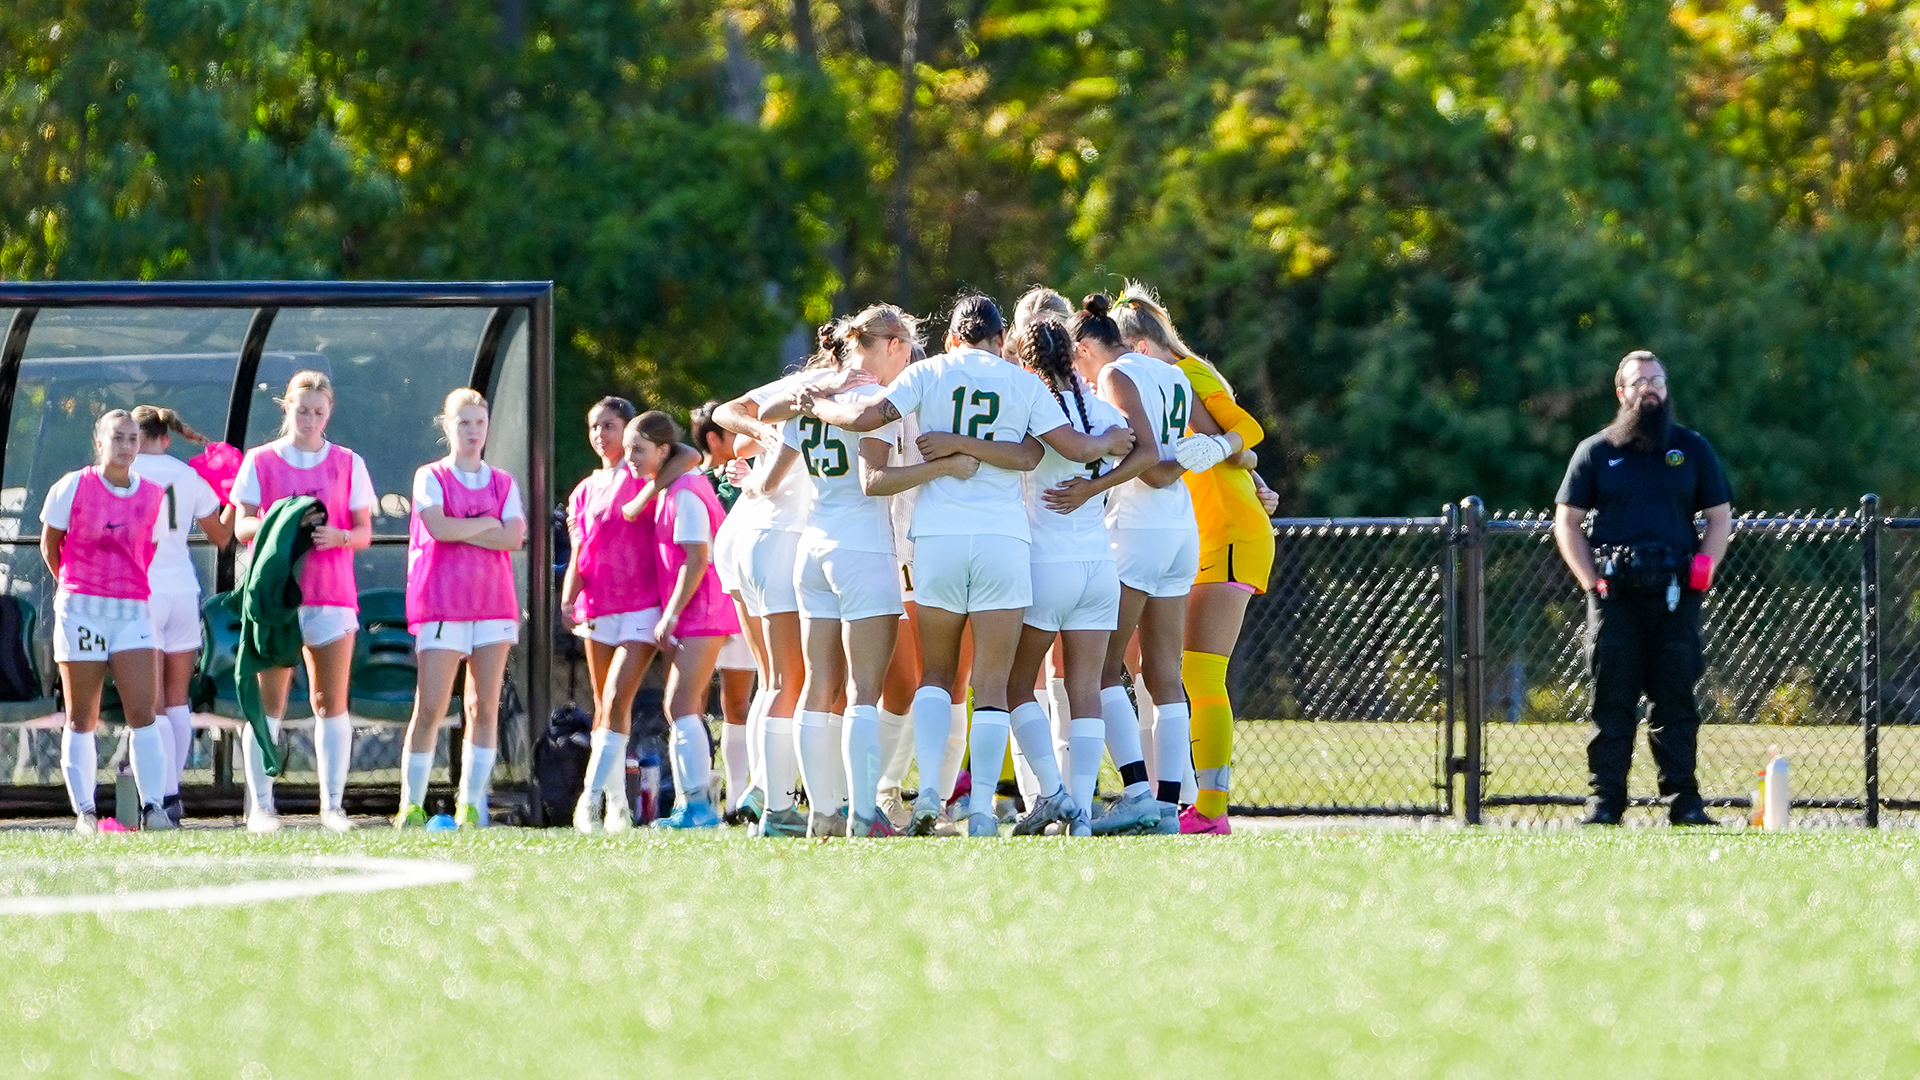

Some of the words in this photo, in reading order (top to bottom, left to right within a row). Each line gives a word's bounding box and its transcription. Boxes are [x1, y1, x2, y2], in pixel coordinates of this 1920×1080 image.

[952, 386, 1000, 441] 12
[1158, 383, 1186, 446] 14
[799, 416, 848, 477] 25
[78, 625, 106, 652] 24
